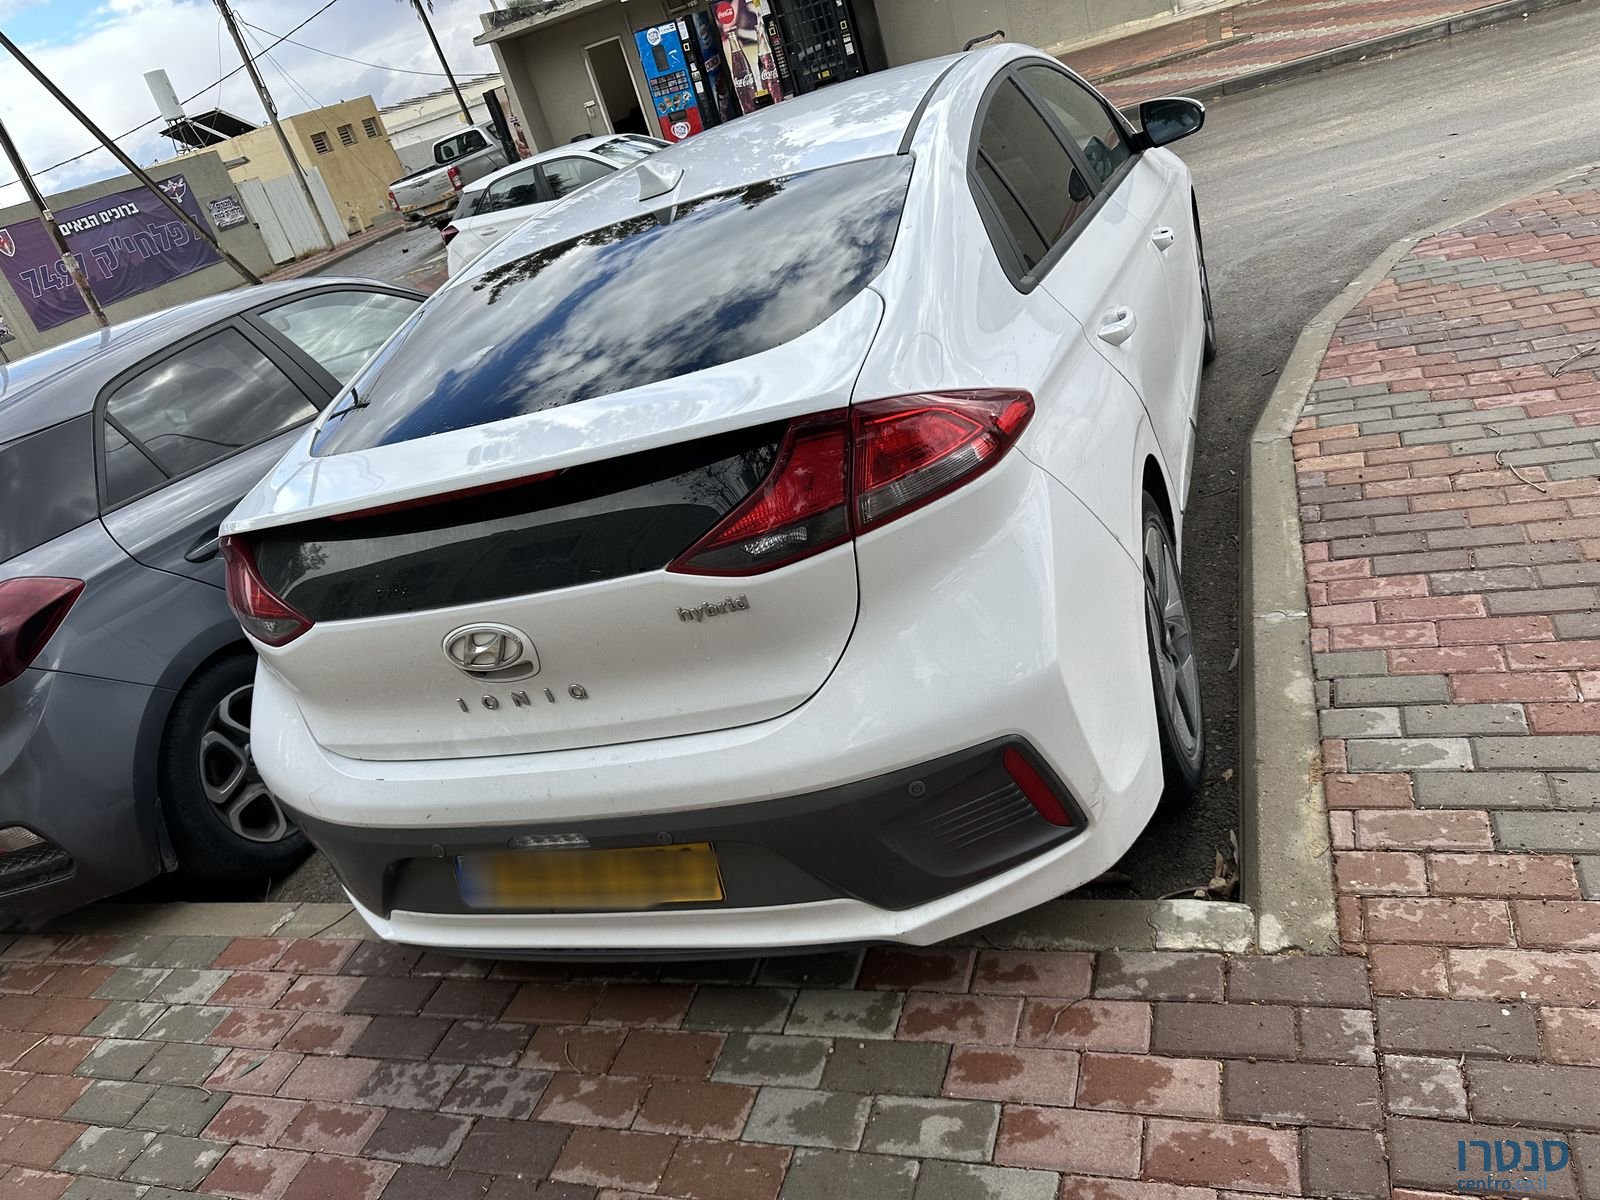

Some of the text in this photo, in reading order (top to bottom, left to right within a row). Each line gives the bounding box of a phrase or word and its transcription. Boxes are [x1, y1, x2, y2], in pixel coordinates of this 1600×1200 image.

[58, 202, 139, 236] ברוכים הבאים
[675, 593, 750, 622] hybrid
[456, 683, 588, 712] IONIQ
